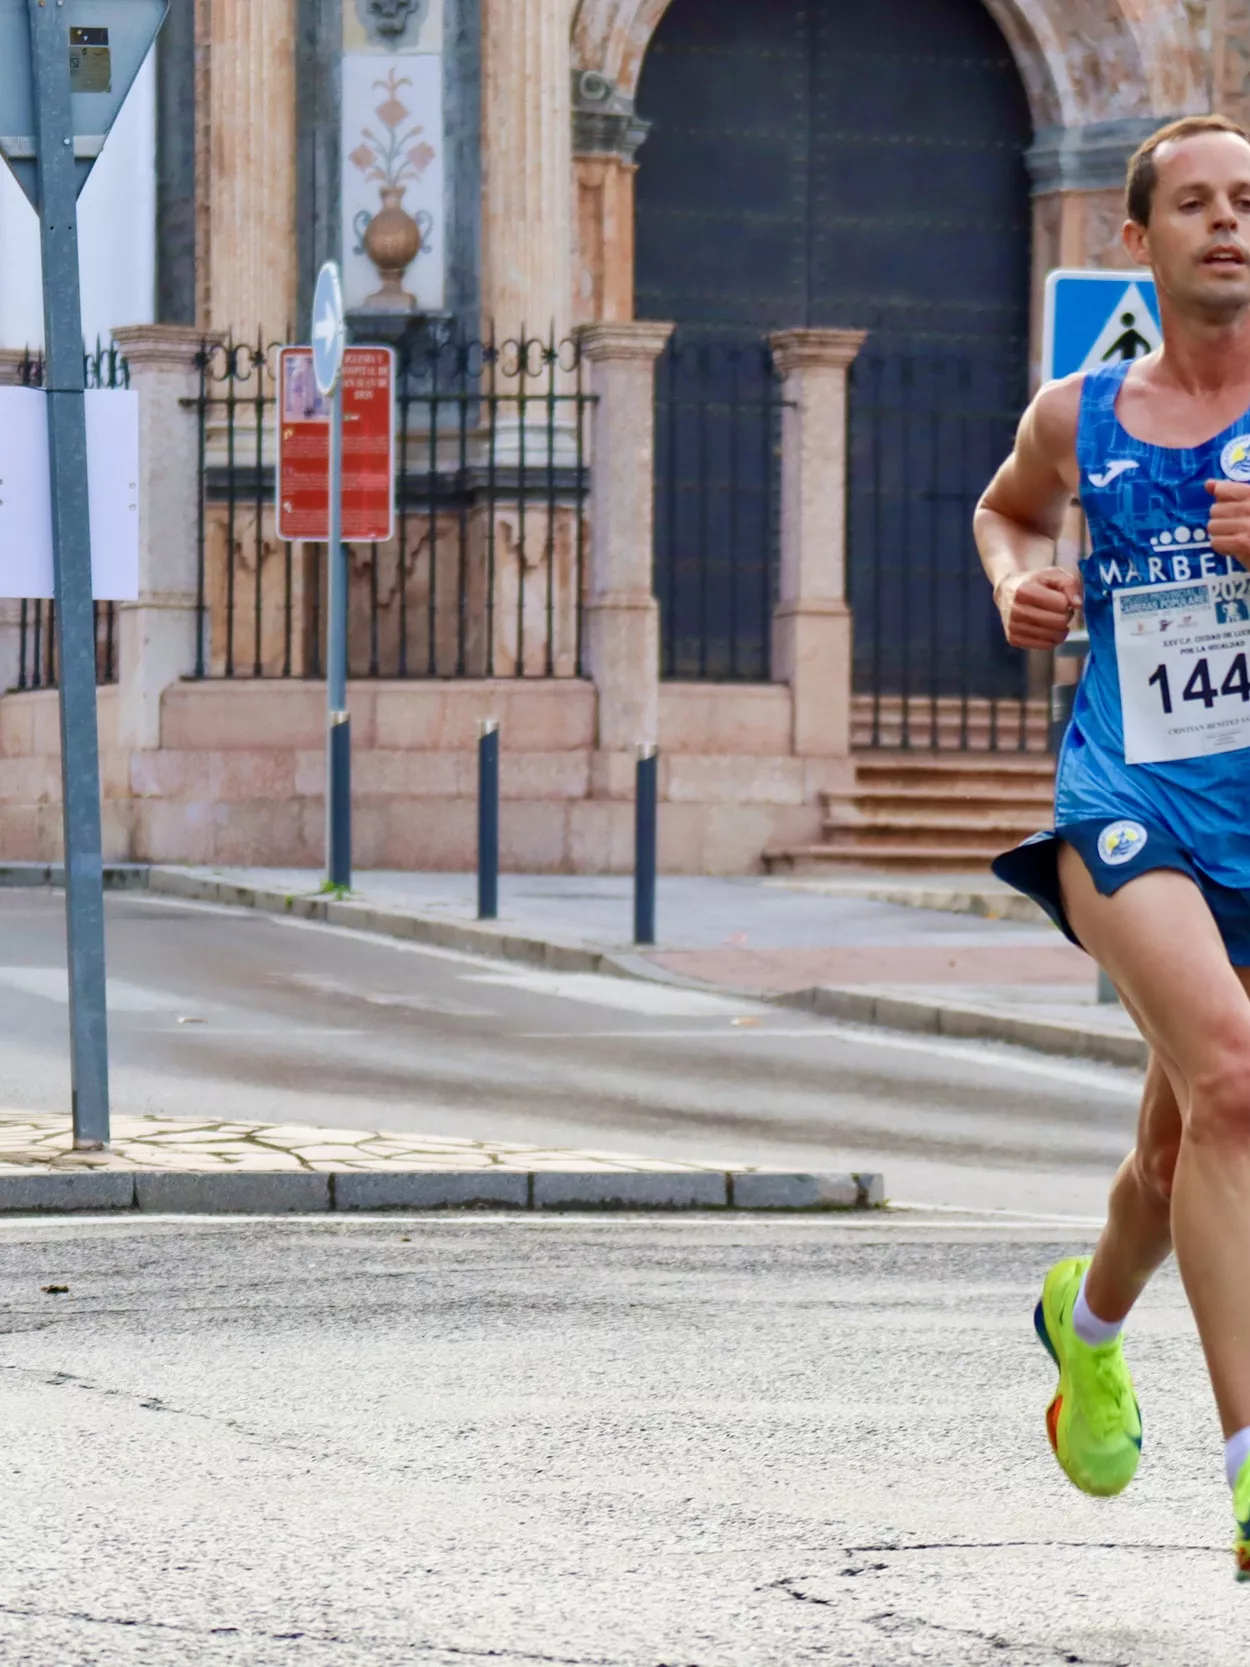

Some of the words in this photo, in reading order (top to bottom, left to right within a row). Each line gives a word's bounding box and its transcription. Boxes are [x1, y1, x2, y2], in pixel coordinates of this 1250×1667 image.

[1099, 553, 1244, 586] MARBEL
[1194, 633, 1221, 643] CIUDAD
[1223, 631, 1233, 639] DE
[1208, 640, 1246, 651] IGUALDAD
[1168, 725, 1205, 736] CRISTIAN
